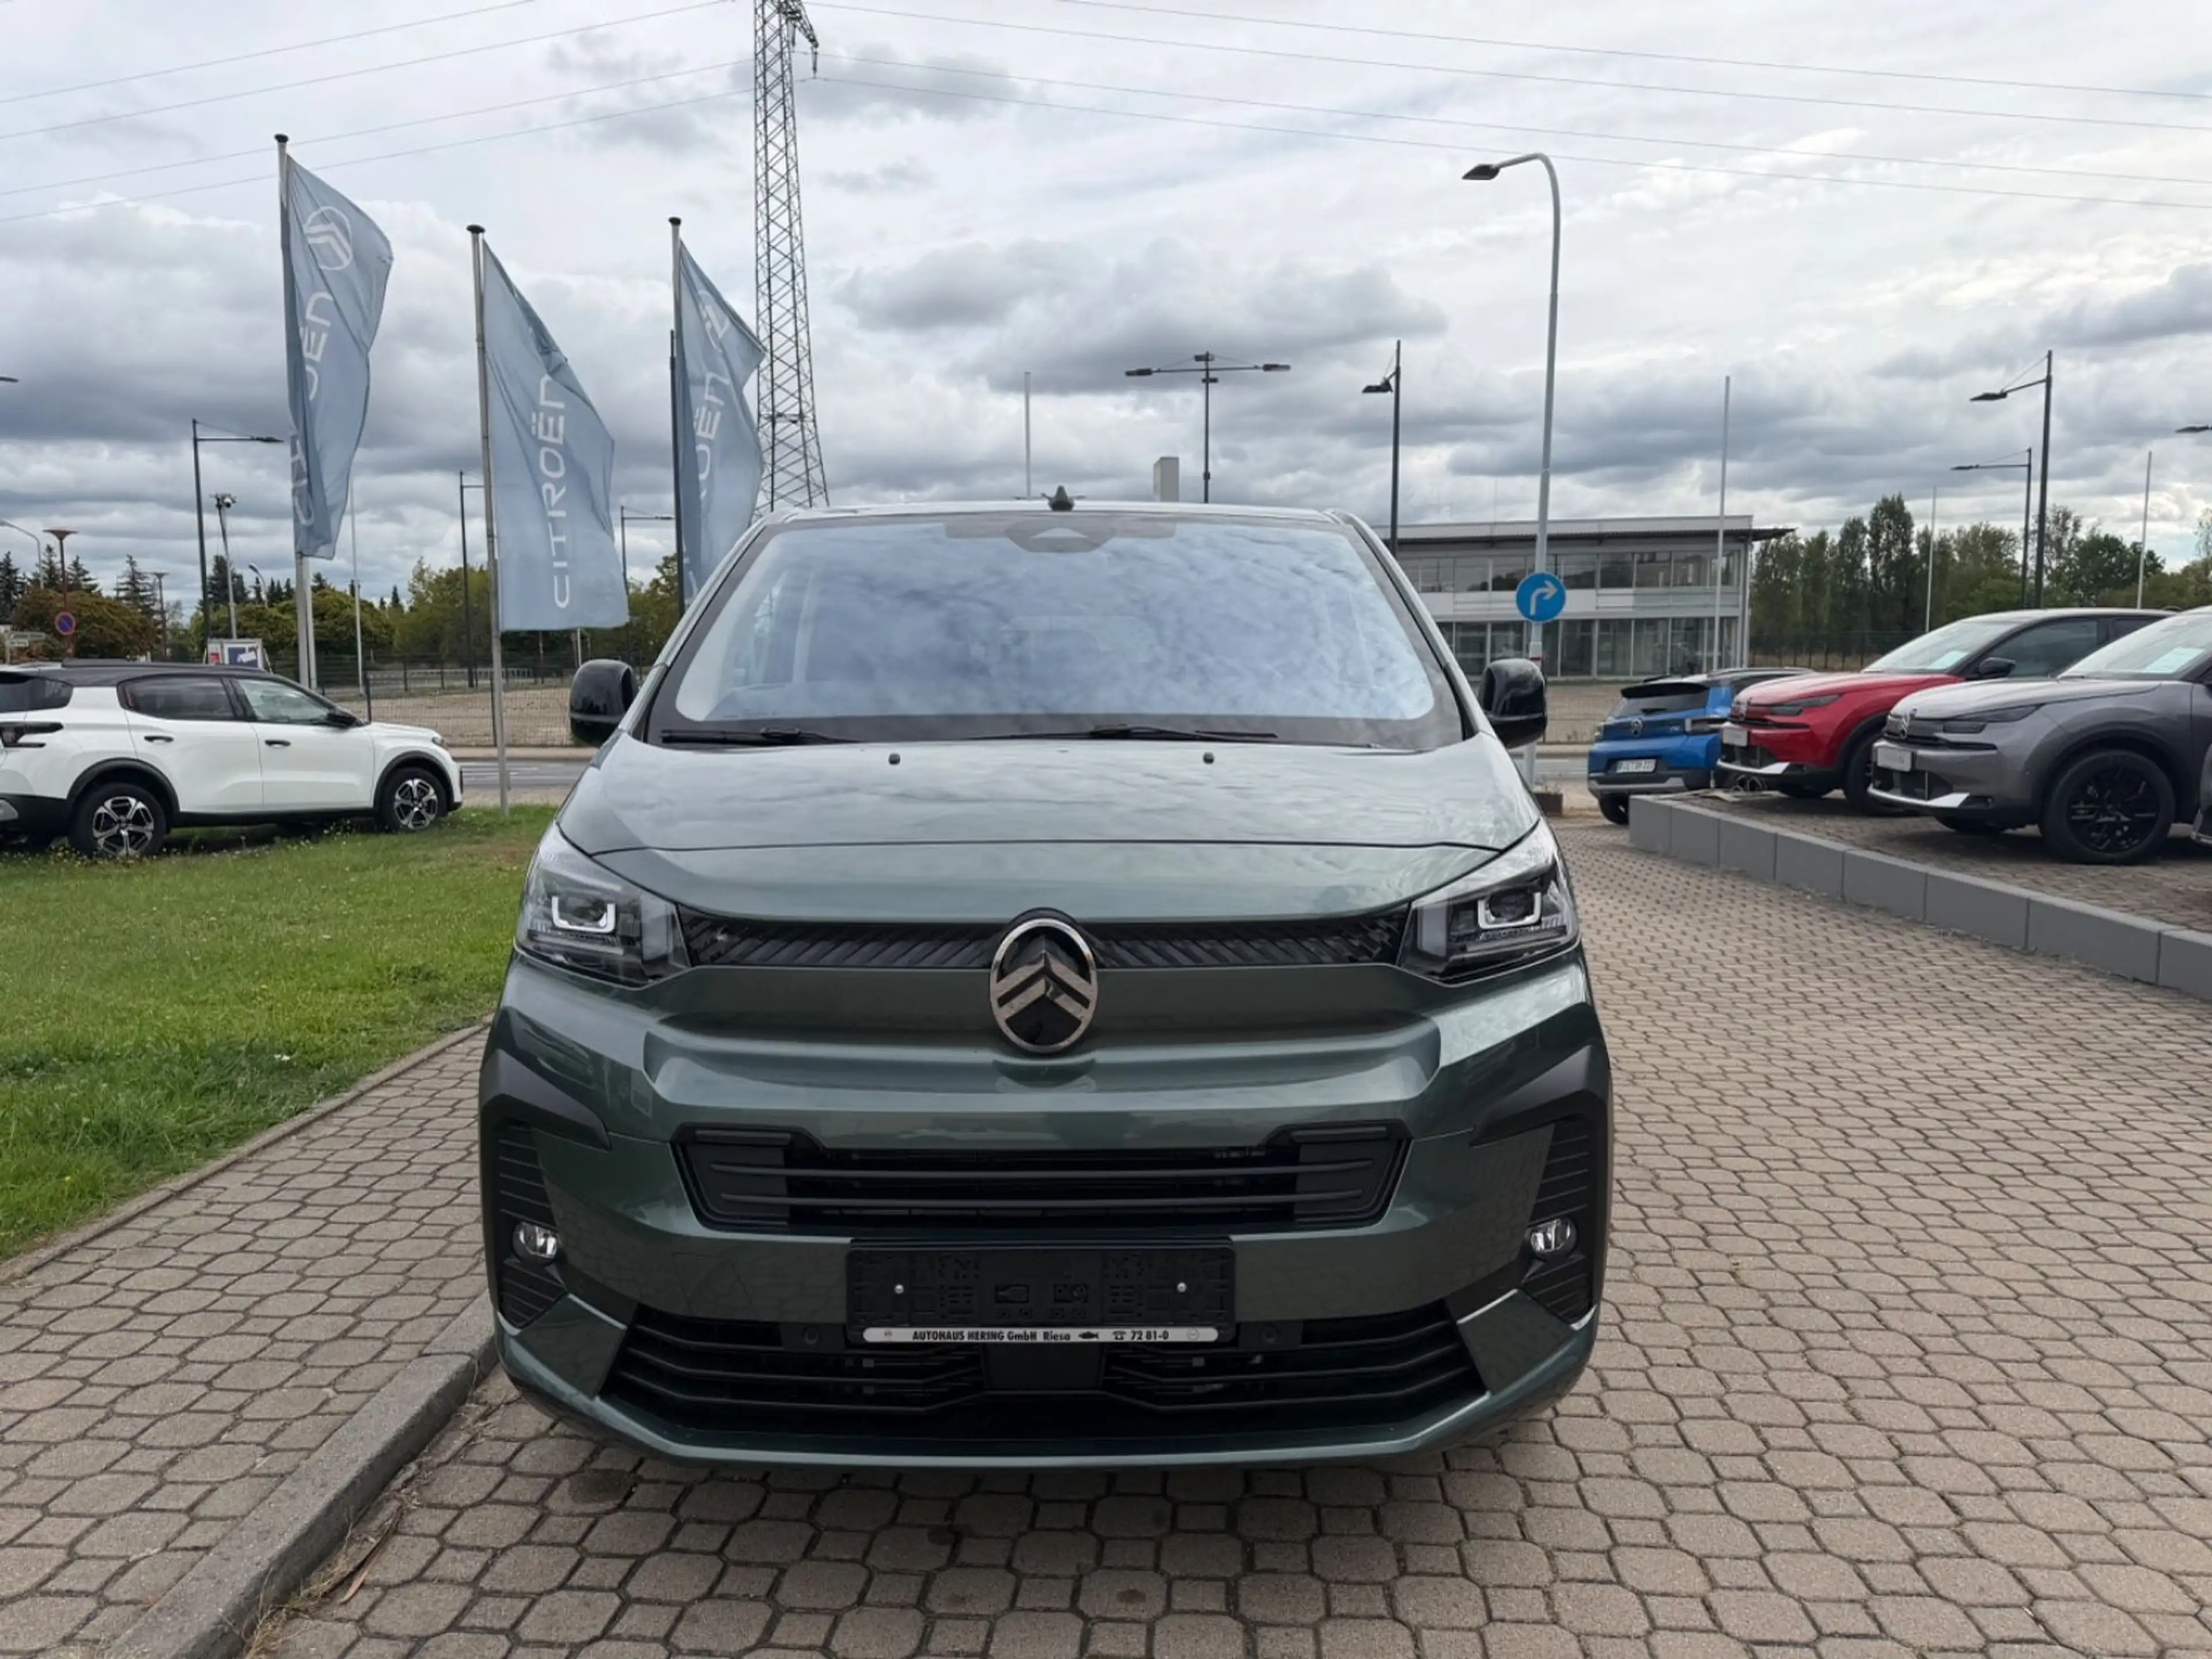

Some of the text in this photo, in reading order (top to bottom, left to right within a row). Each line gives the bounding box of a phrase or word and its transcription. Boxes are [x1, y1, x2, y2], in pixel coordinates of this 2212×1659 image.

[912, 1330, 965, 1341] AUTOHAUS
[967, 1330, 1005, 1341] HERING
[1007, 1330, 1037, 1341] GmbH
[1130, 1330, 1143, 1340] 72
